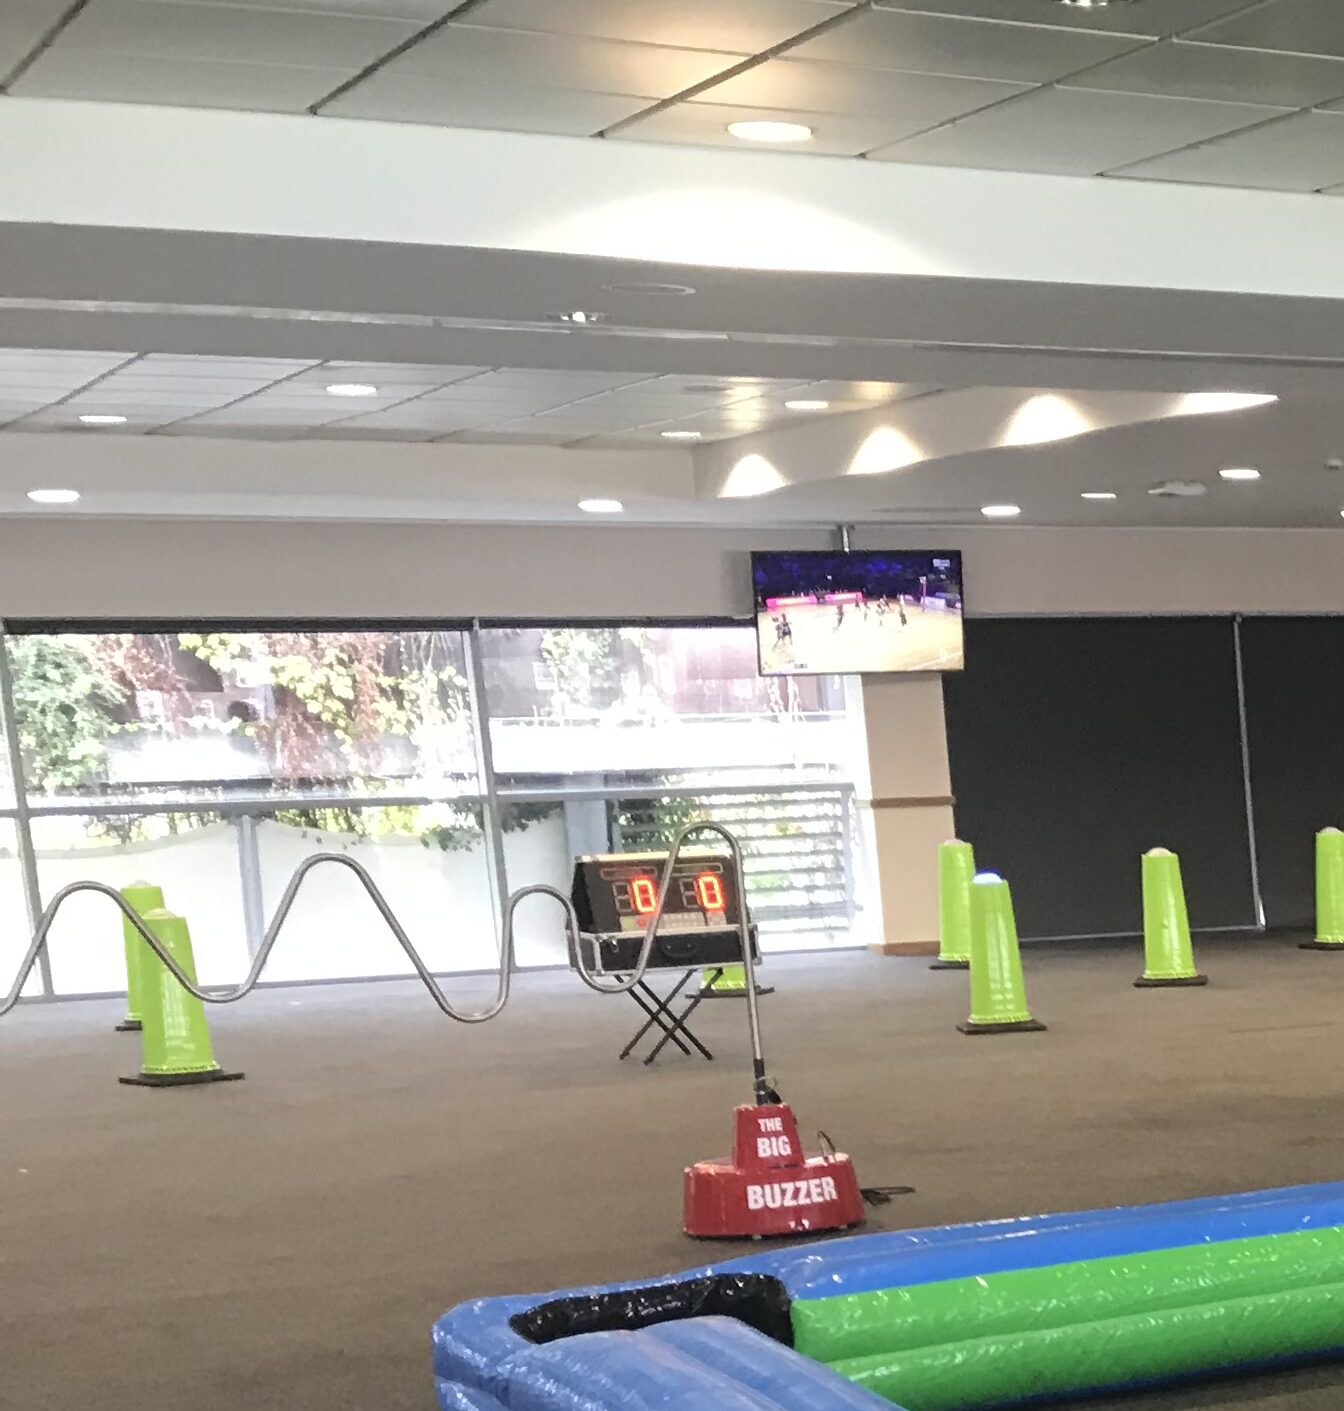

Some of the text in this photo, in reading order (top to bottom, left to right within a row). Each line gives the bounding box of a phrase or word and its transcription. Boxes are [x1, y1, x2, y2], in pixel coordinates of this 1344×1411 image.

[632, 879, 657, 913] 0
[698, 876, 723, 909] 0
[757, 1117, 783, 1133] THE
[756, 1135, 792, 1158] BIG
[746, 1176, 838, 1210] BUZZER
